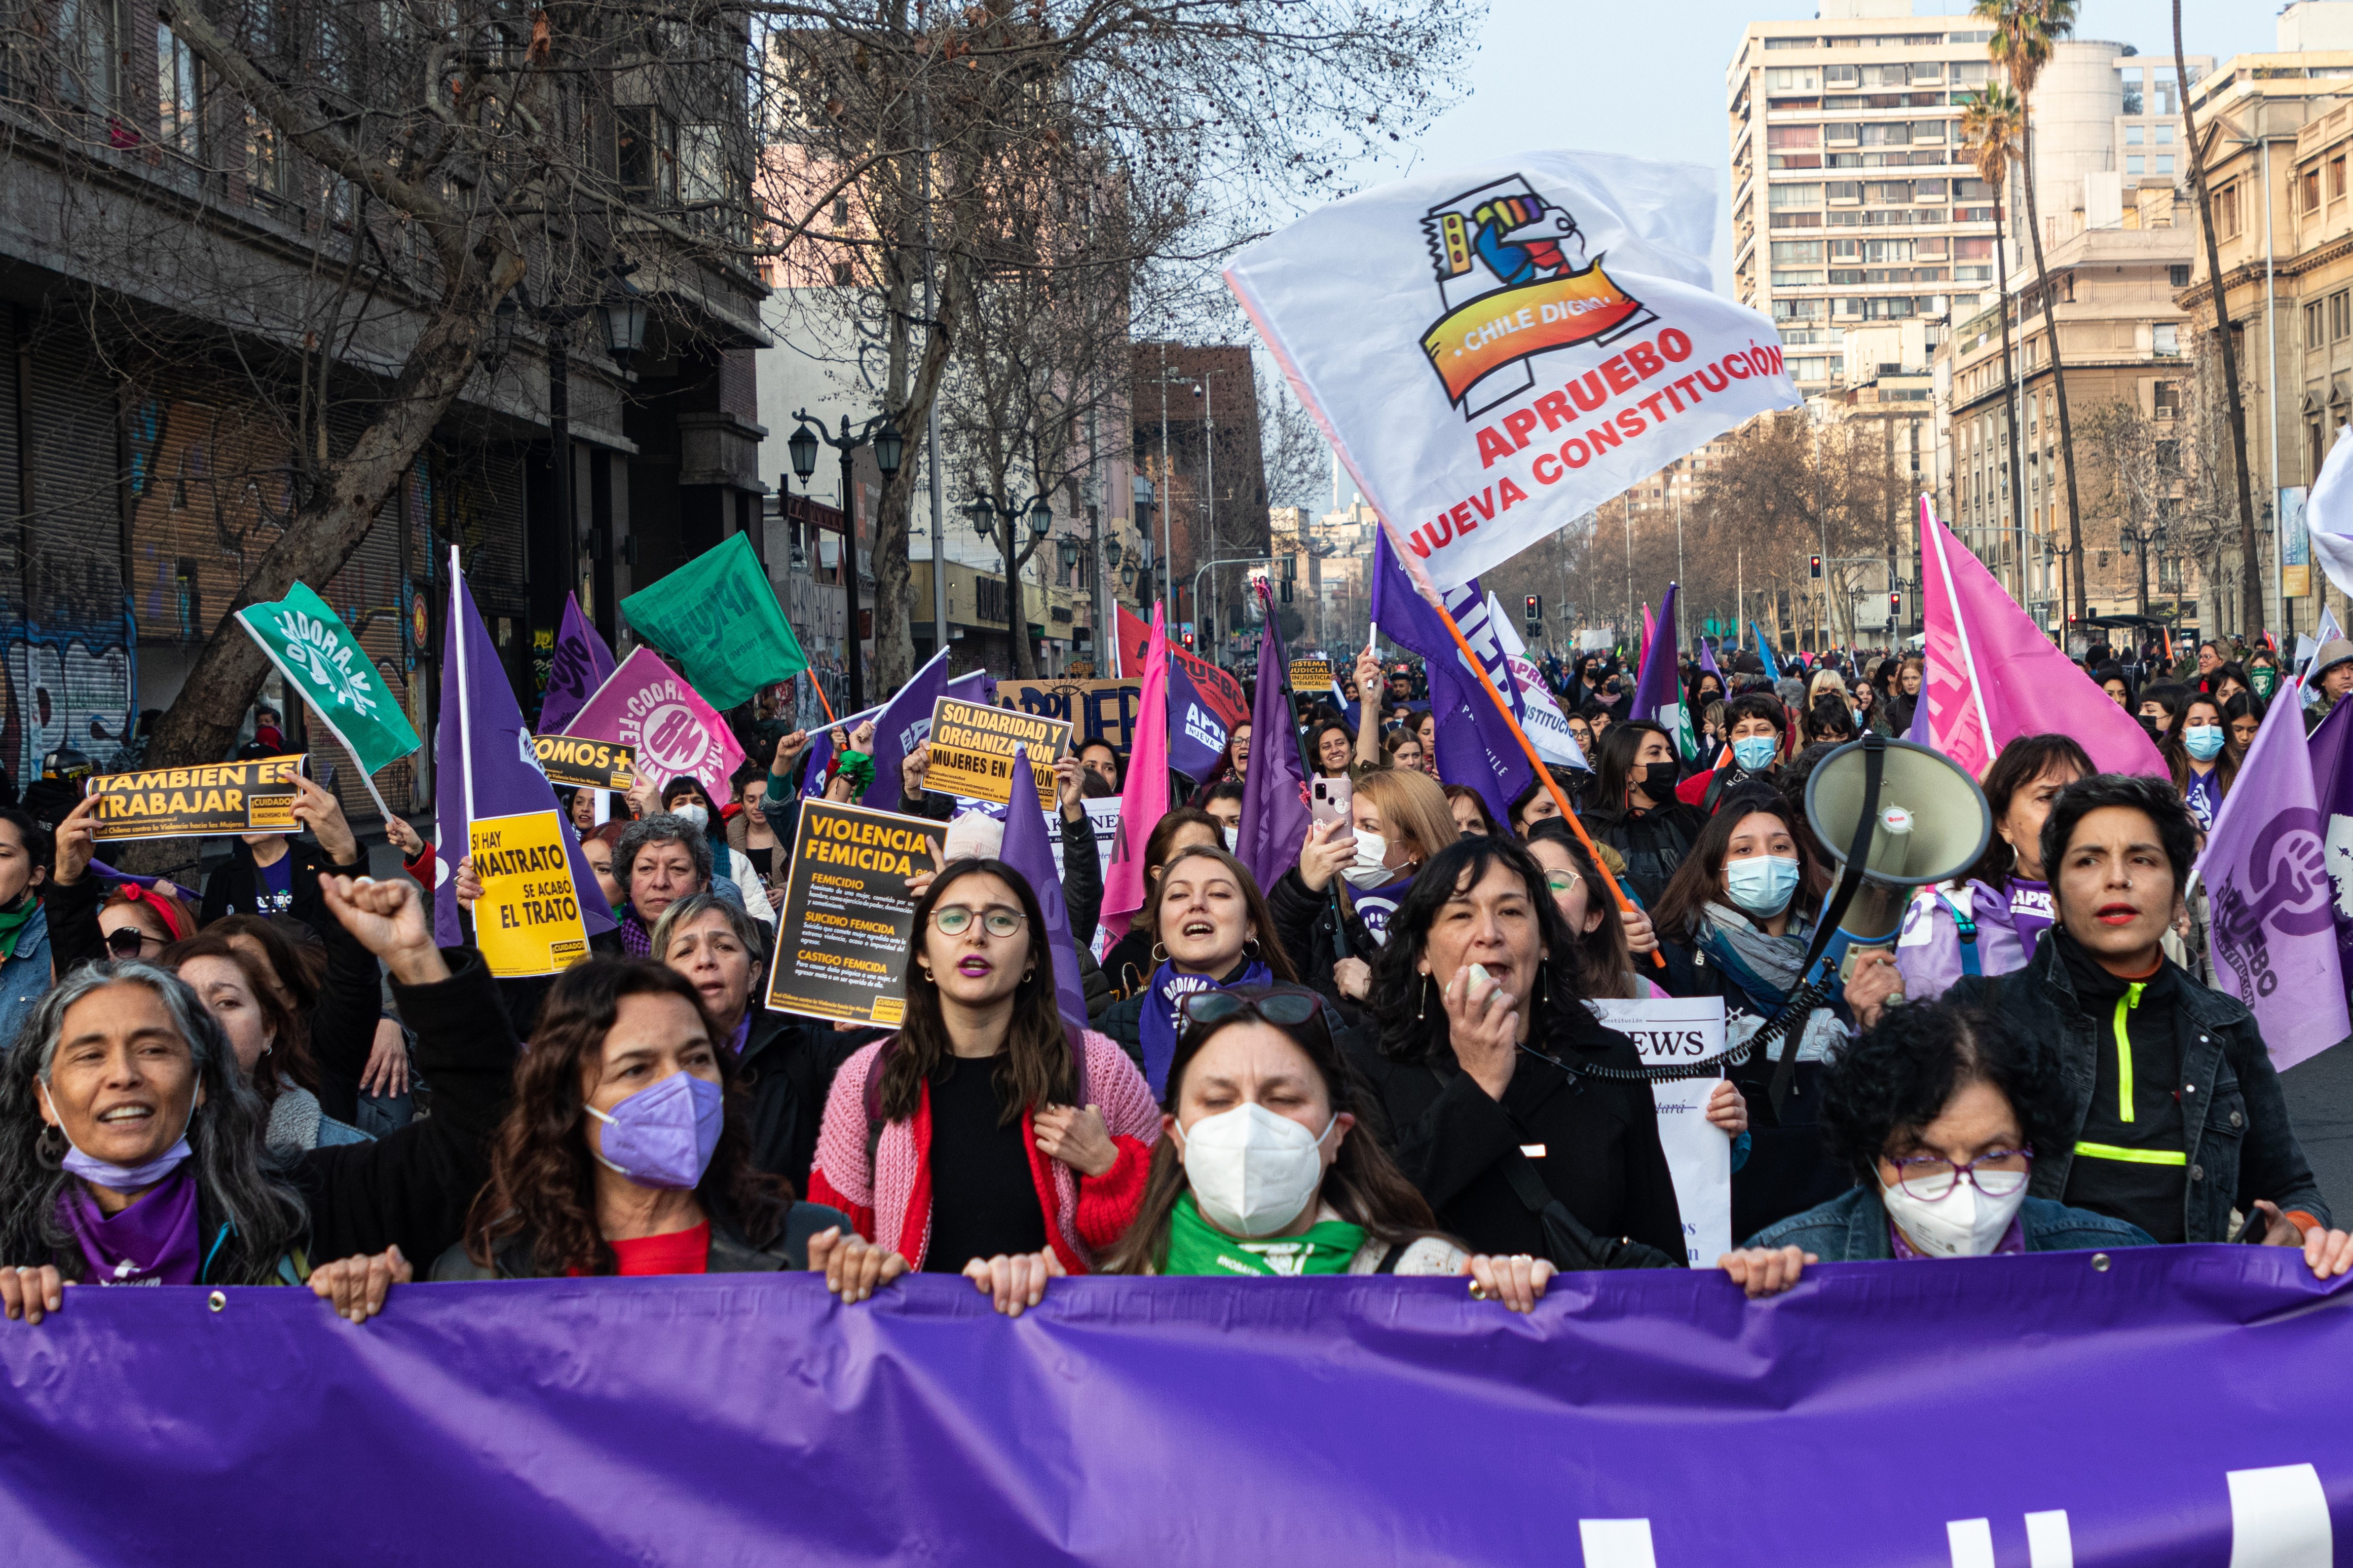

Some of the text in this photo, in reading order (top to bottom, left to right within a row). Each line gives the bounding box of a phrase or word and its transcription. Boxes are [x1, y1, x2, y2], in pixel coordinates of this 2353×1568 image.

[1465, 310, 1536, 352] CHILE
[1475, 327, 1692, 469] APRUEBO
[1409, 339, 1783, 559] NUEVA CONSTITUCIÓN
[942, 703, 1047, 741] SOLIDARIDAD
[1052, 725, 1063, 743] Y
[939, 725, 1056, 764] ORGANIZAIÓN
[1189, 726, 1215, 747] NUEVA
[532, 738, 610, 769] OMOS
[932, 749, 987, 775] MUJERES
[991, 759, 1007, 778] EN
[95, 766, 247, 792] TAMBIEN
[258, 762, 294, 784] ES
[100, 788, 244, 819] TRABAJAR
[108, 826, 132, 834] Chilena
[160, 822, 189, 830] Violencia
[190, 821, 207, 829] hacia
[219, 821, 245, 829] Mujeres
[811, 814, 926, 855] VIOLENCIA
[472, 830, 502, 851] SI HAY
[472, 844, 565, 879] MALTRATO
[805, 838, 912, 876] FEMICIDA
[523, 876, 572, 898] SE ACABÓ
[811, 872, 864, 891] FEMICIDIO
[809, 891, 829, 901] hombre,
[869, 900, 885, 910] poder,
[884, 903, 913, 914] dominación
[810, 883, 834, 893] Asesinato
[855, 891, 871, 900] mujer,
[873, 893, 895, 903] cometido
[897, 899, 906, 907] por
[812, 899, 846, 910] sometimiento.
[500, 896, 577, 929] EL TRATO
[804, 911, 895, 936] SUICIDIO FEMICIDA
[800, 937, 820, 945] agresor.
[802, 930, 823, 938] extrema
[824, 933, 847, 943] violencia,
[870, 940, 896, 951] impunidad
[803, 922, 823, 931] Suicidio
[823, 926, 833, 934] que
[834, 928, 851, 936] comete
[851, 930, 866, 939] mujer
[867, 932, 889, 943] agredida
[796, 960, 808, 968] Para
[809, 963, 827, 971] causar
[827, 965, 840, 974] daño
[841, 968, 861, 978] psíquico
[877, 975, 891, 983] mujer,
[797, 949, 887, 974] CASTIGO FEMICIDA
[848, 977, 867, 987] querido
[1622, 1030, 1704, 1056] EWS
